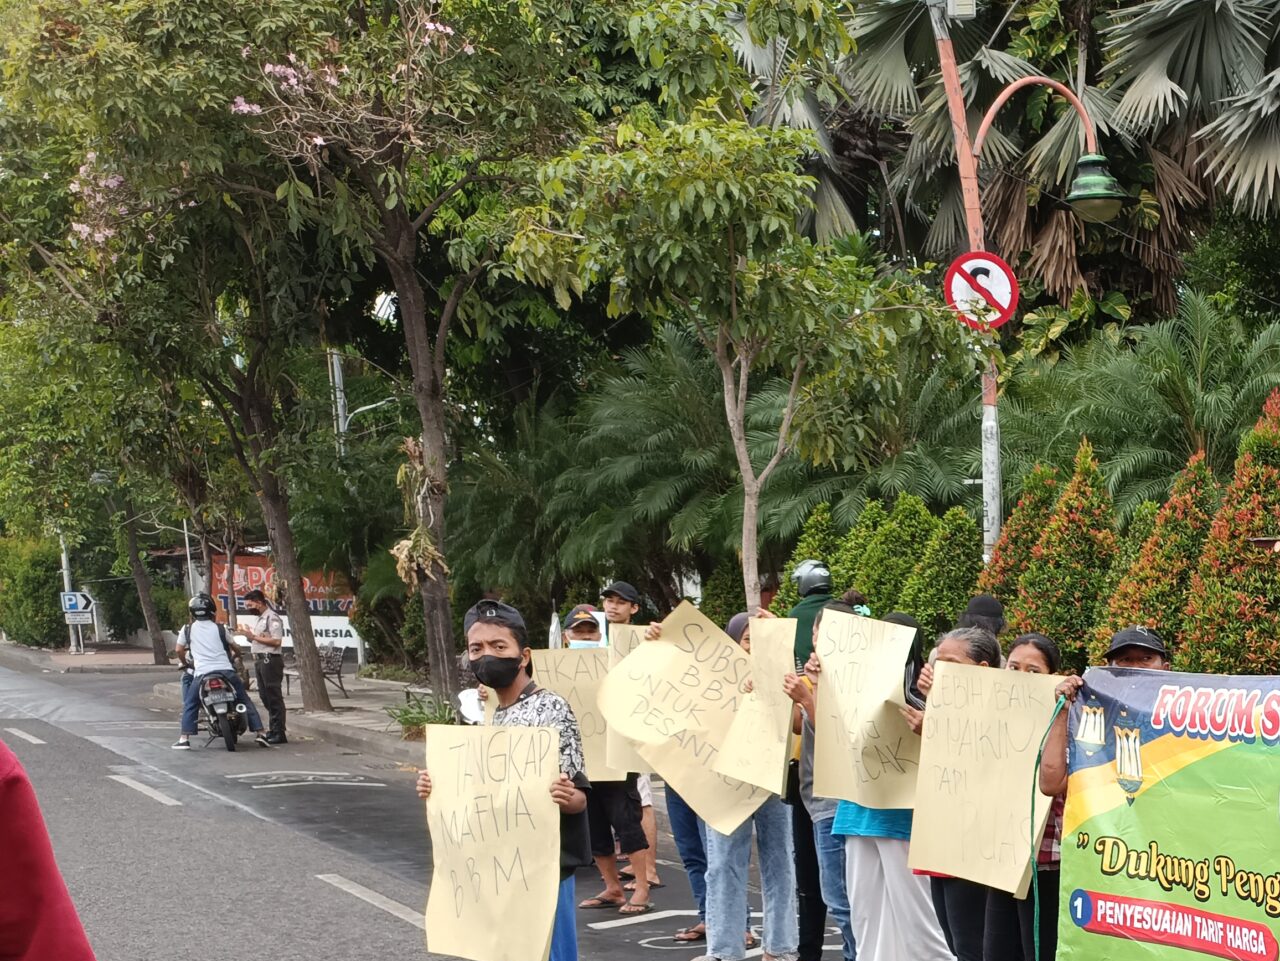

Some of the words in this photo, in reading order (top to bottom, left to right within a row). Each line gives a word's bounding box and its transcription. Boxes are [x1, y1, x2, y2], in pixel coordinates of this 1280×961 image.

[64, 595, 77, 609] P
[282, 628, 353, 638] INNESIA
[930, 674, 985, 712] LEBIH
[993, 678, 1047, 712] BAIK
[1151, 685, 1261, 741] FORUM
[449, 729, 552, 797] TANGKAP
[449, 847, 529, 919] BBM
[1095, 837, 1210, 901] Dukung
[1073, 897, 1083, 920] 1
[1097, 900, 1193, 938] PENYESUAIAN
[1194, 916, 1225, 944] TARIF
[1226, 925, 1267, 956] HARGA
